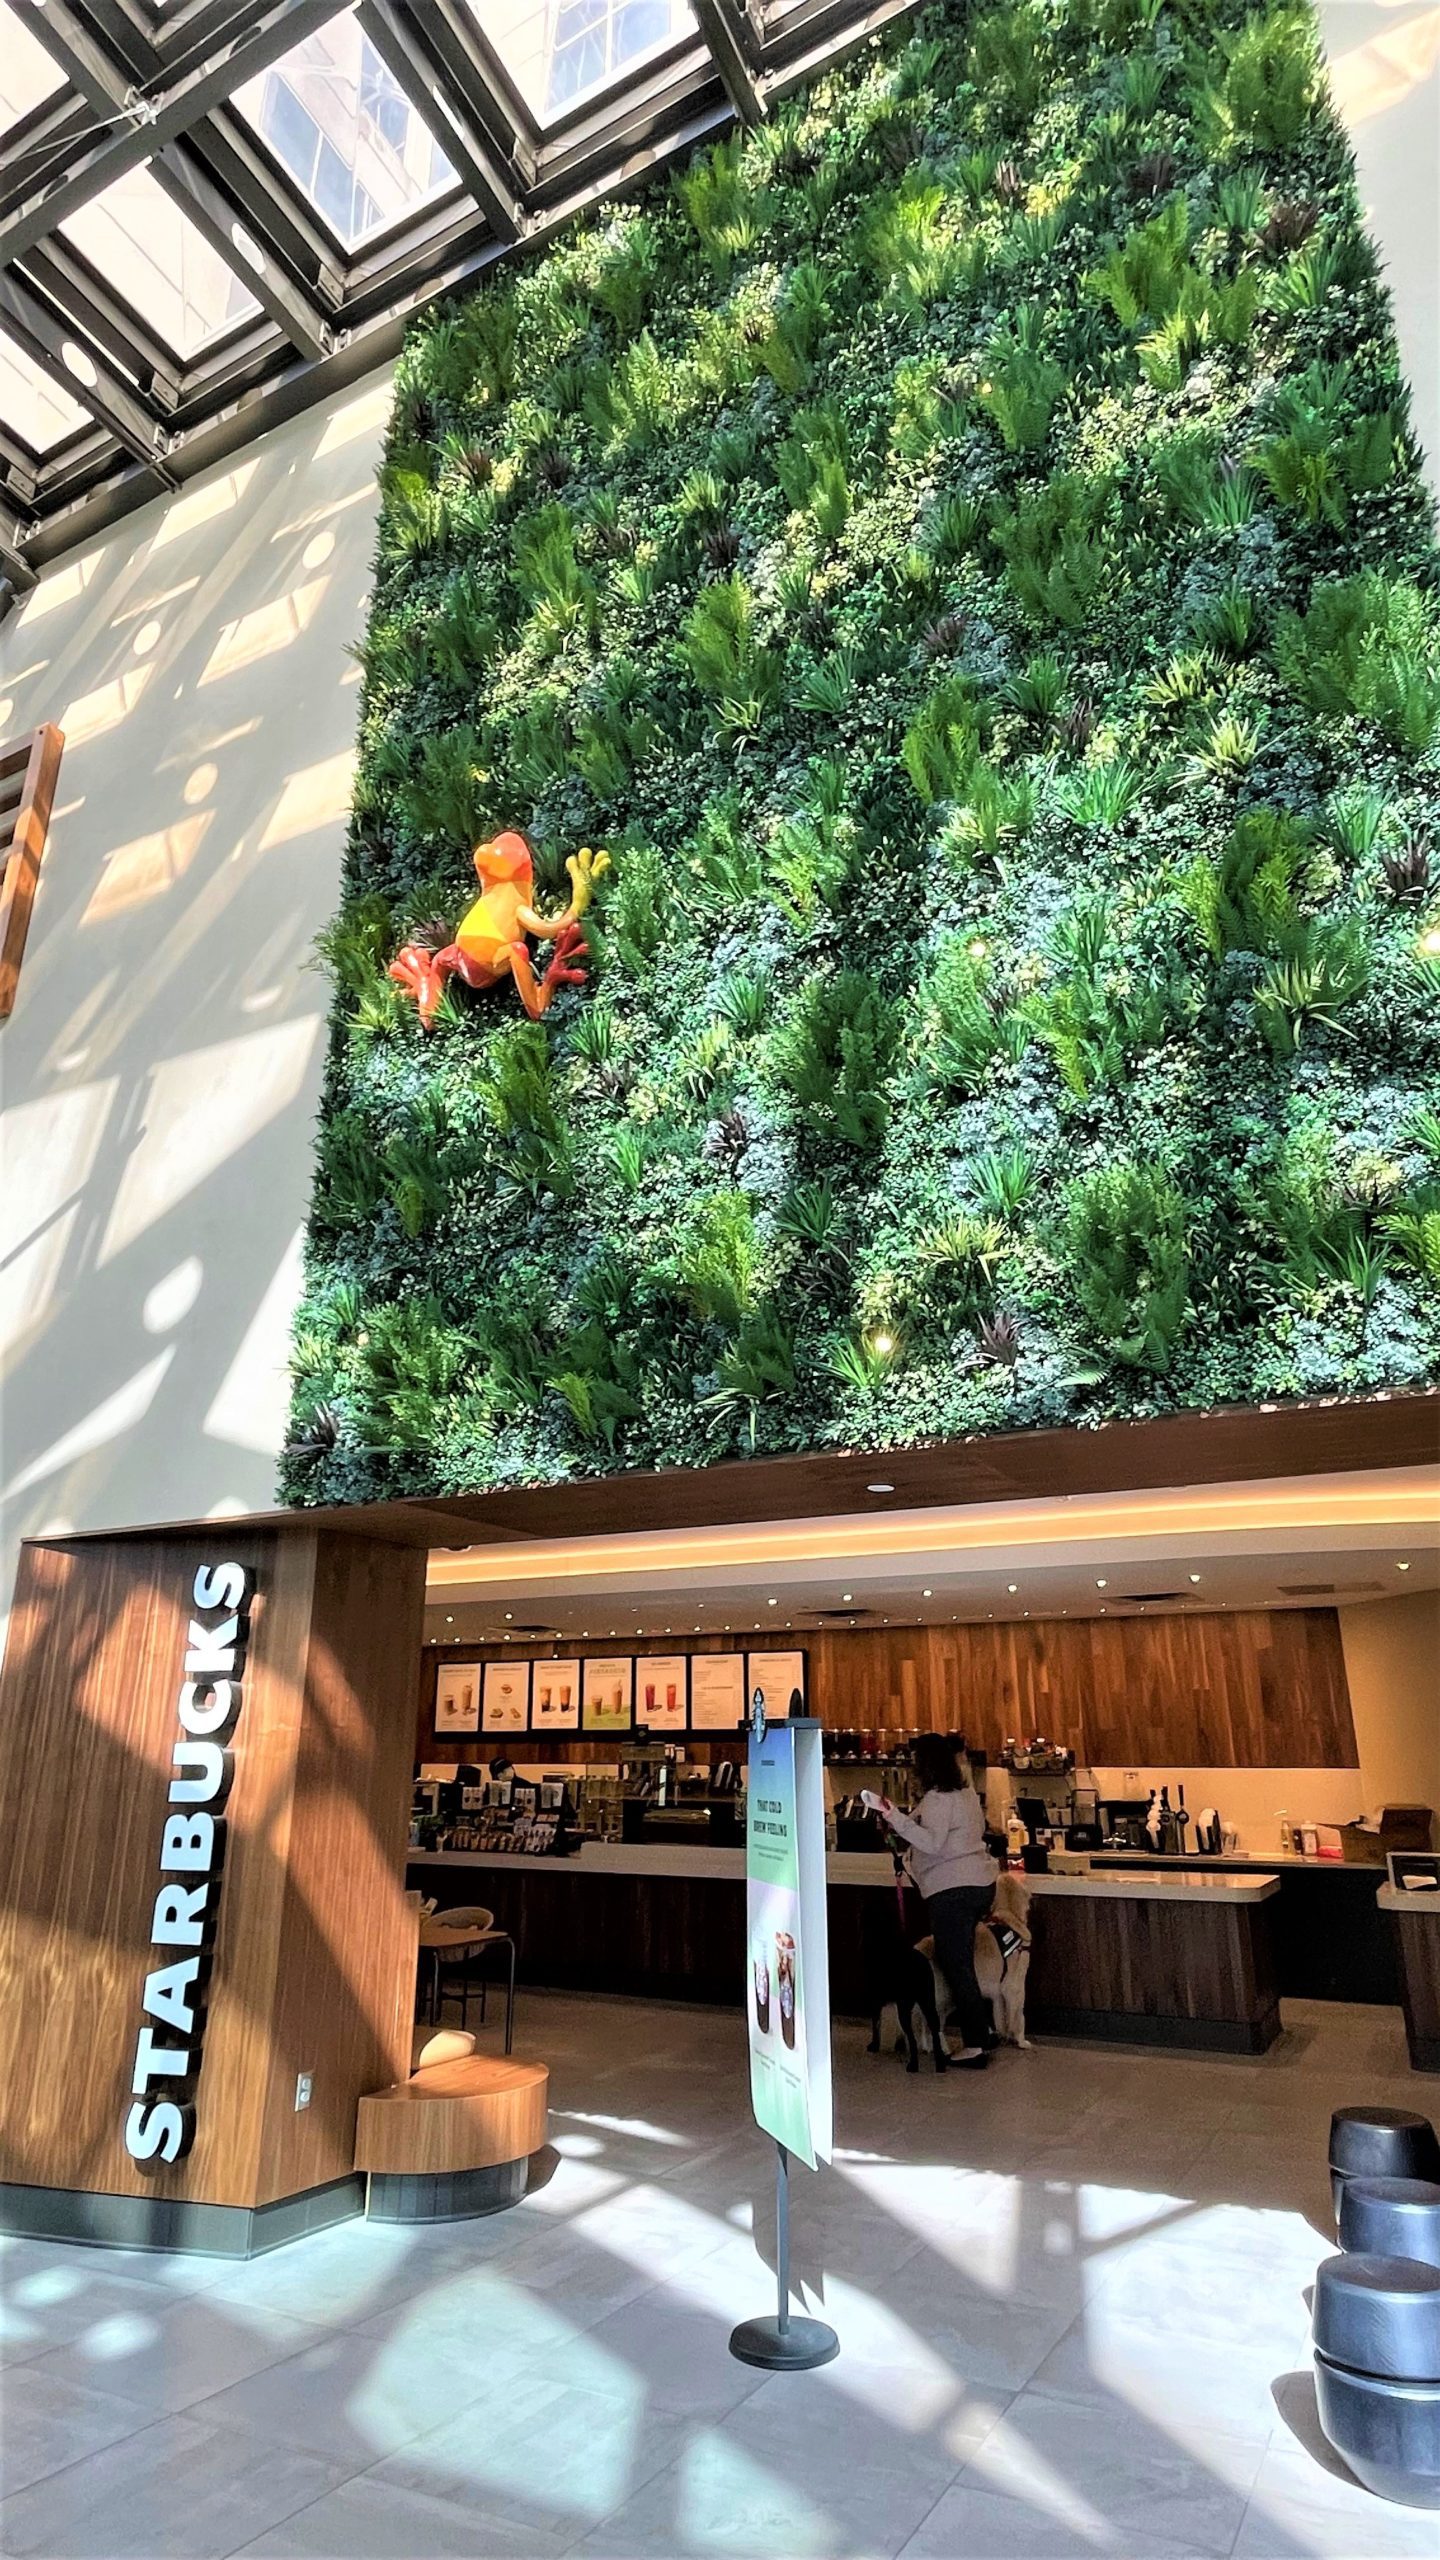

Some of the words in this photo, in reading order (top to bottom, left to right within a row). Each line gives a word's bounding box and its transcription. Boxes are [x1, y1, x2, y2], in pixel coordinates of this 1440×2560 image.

[757, 1799, 768, 1812] THAT
[769, 1800, 782, 1813] COLD
[753, 1820, 766, 1833] BREW
[767, 1822, 787, 1837] FEELING
[125, 1560, 248, 2166] STARBUCKS
